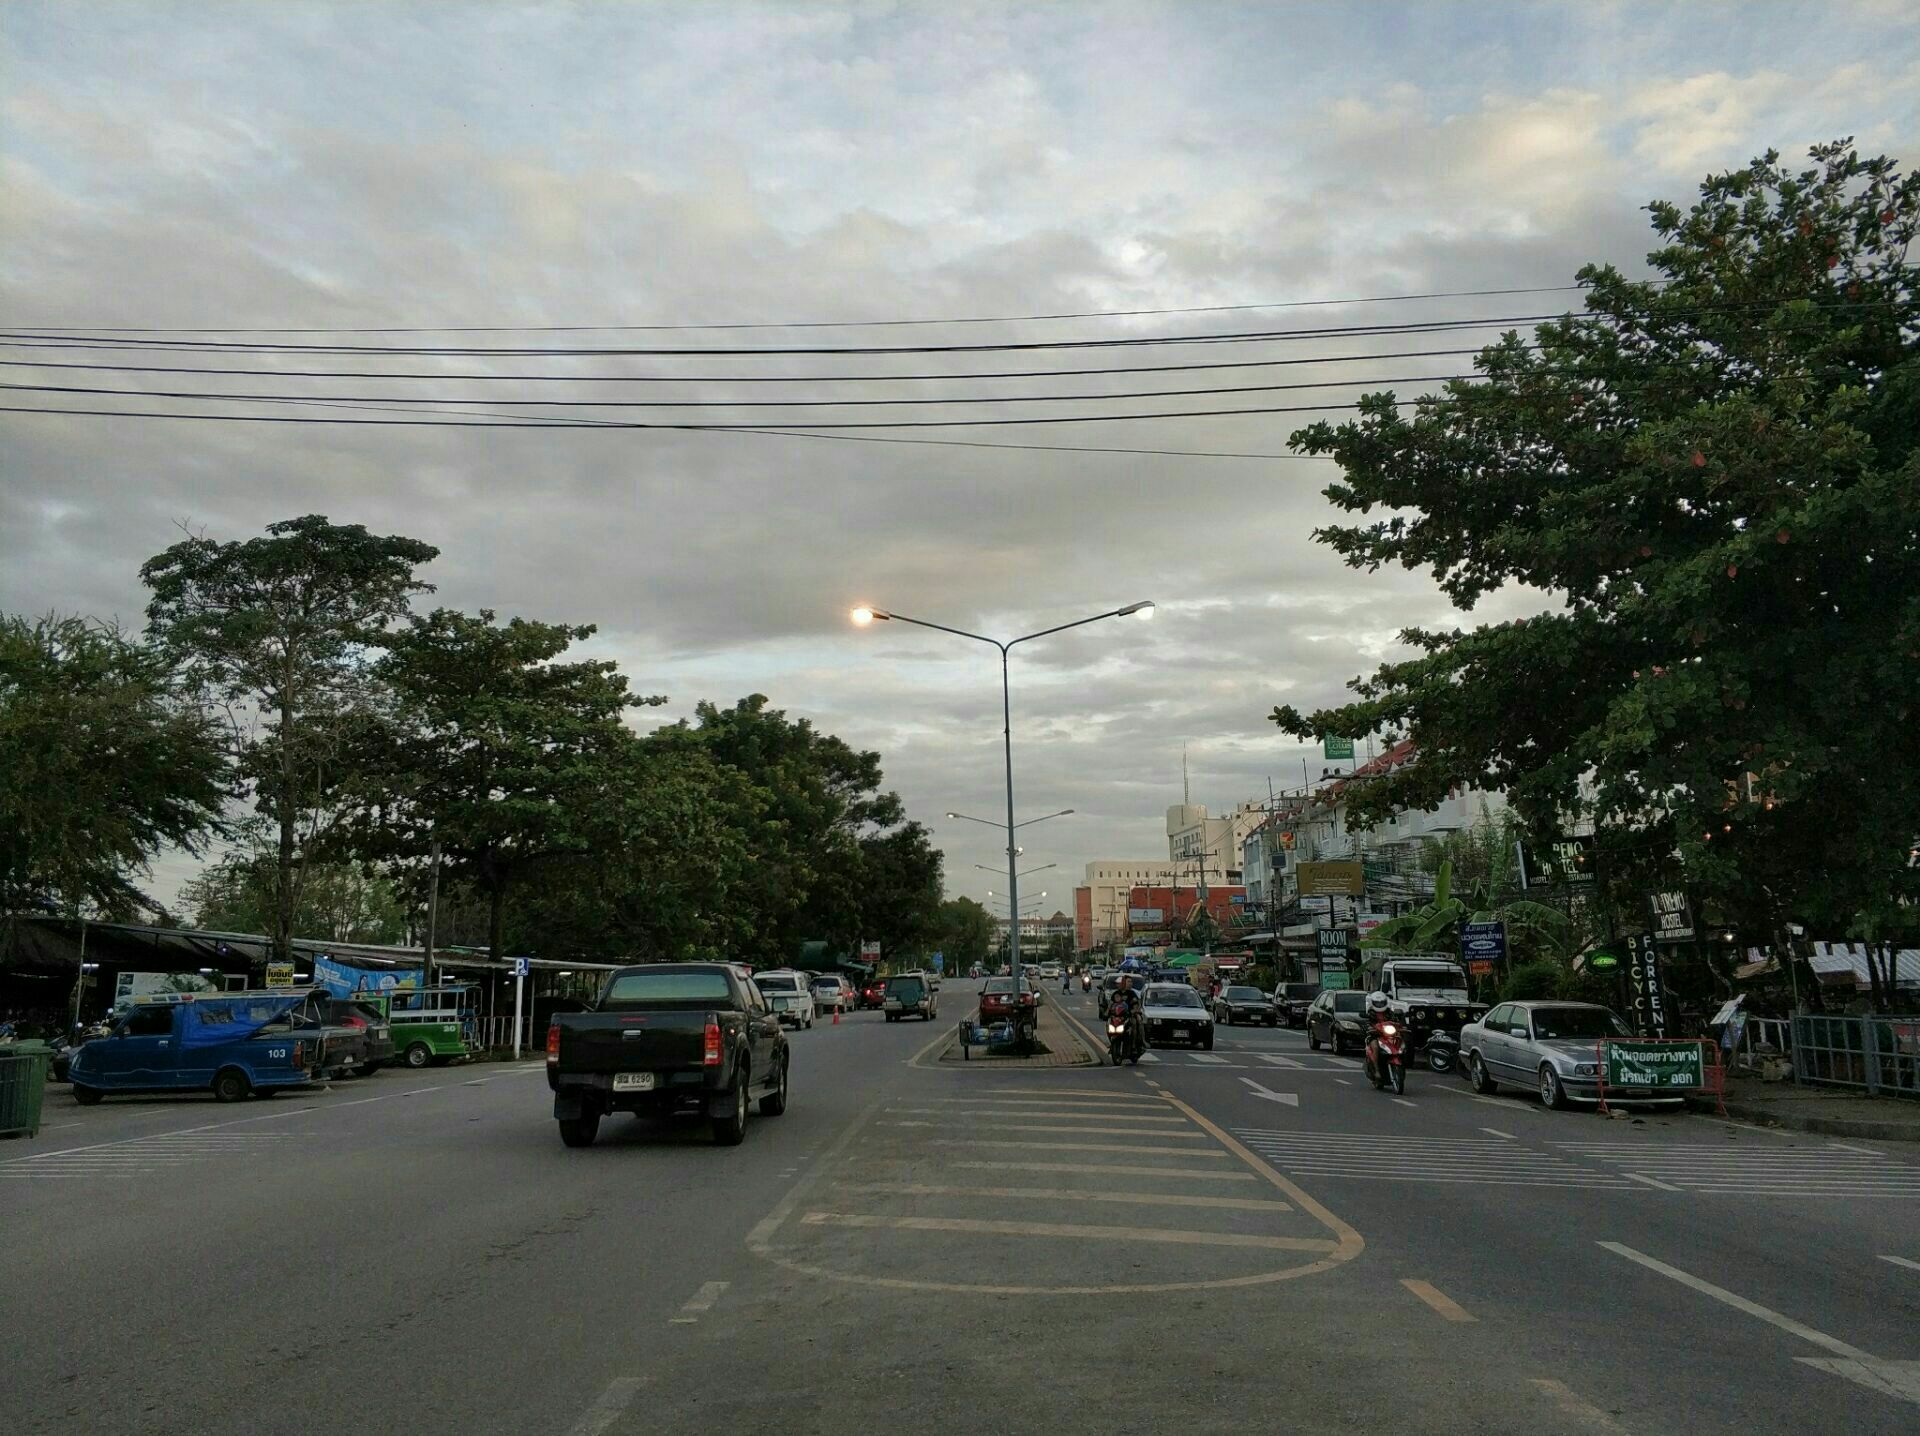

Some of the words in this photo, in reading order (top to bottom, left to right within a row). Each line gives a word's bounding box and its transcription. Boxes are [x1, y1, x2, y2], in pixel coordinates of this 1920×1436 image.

[1660, 913, 1684, 930] HOSTEL
[1320, 930, 1347, 946] ROOM
[267, 1048, 287, 1059] 103
[1670, 1072, 1693, 1084] ออก
